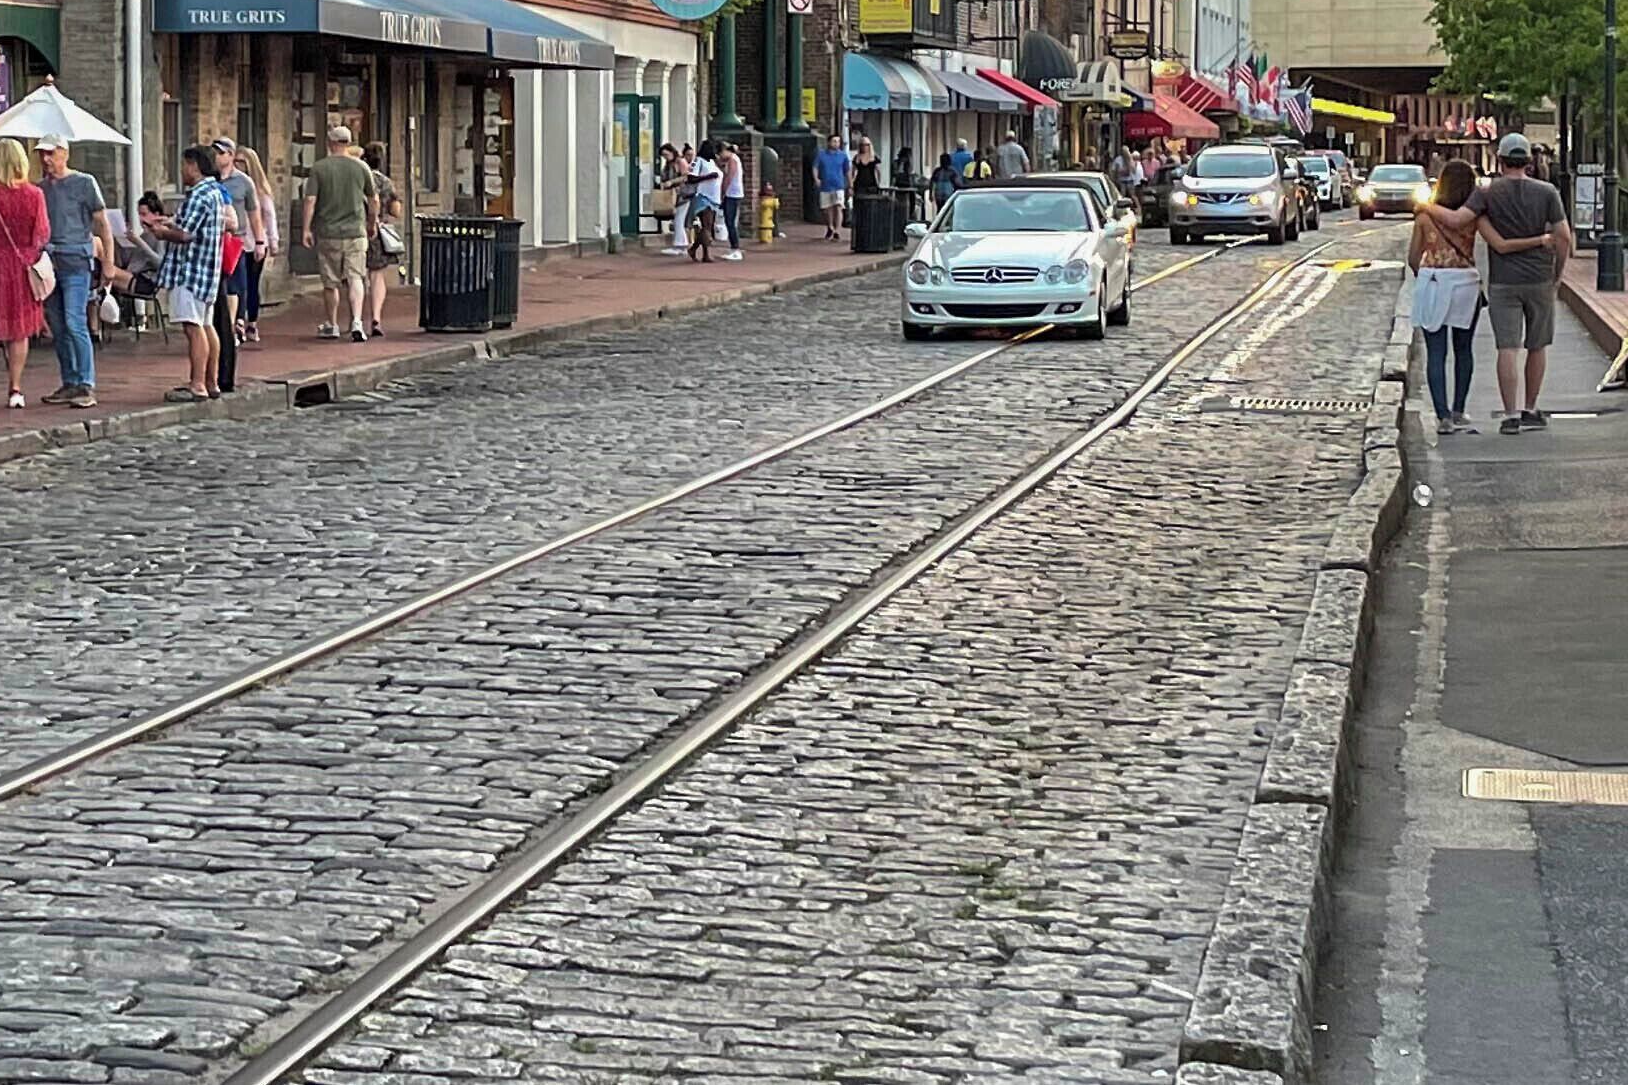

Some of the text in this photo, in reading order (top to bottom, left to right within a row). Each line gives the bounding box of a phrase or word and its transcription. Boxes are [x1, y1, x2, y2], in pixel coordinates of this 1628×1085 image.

[188, 10, 285, 24] TRUE GRITS
[380, 11, 441, 46] TRUE GRITS
